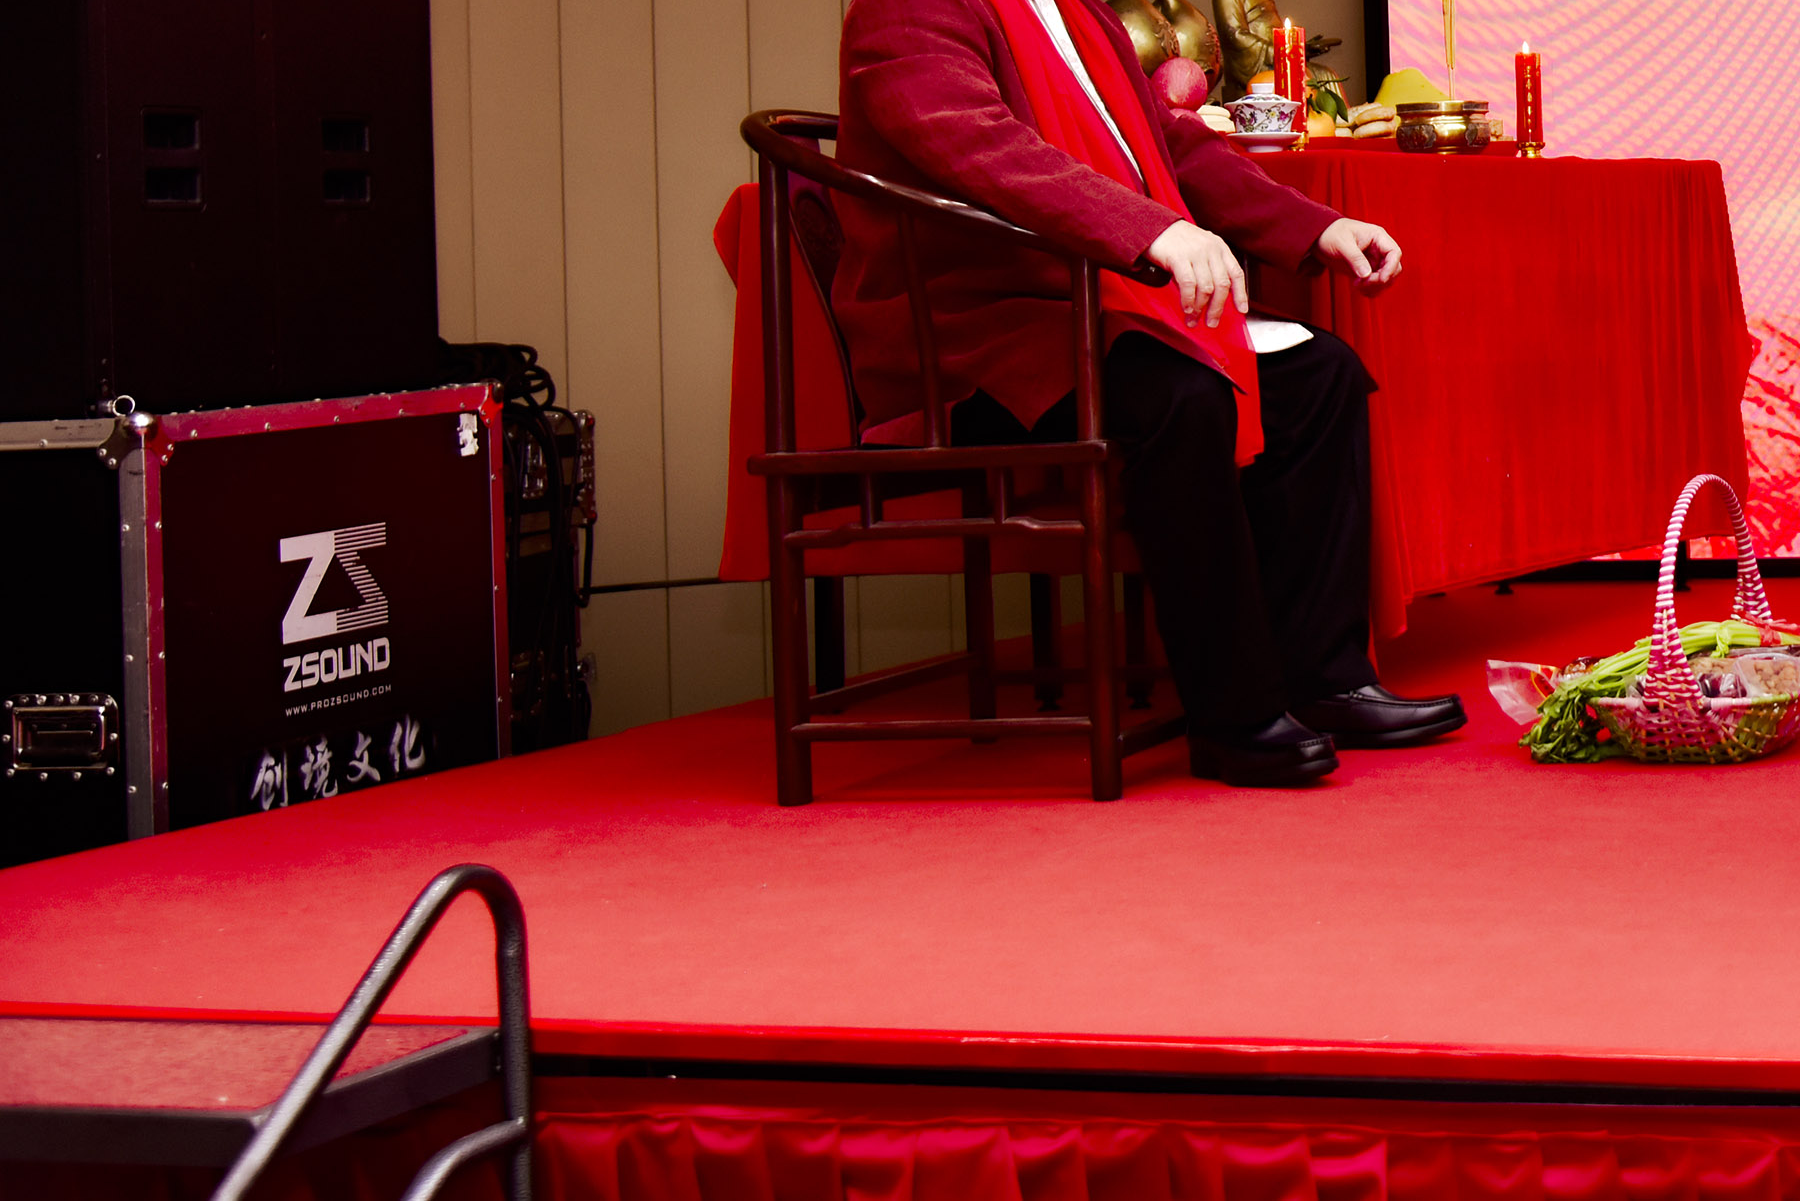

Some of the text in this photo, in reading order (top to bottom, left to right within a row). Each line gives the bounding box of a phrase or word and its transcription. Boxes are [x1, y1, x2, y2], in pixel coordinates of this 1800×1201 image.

[283, 636, 391, 693] ZSOUND
[285, 683, 393, 717] WWW.PROZSOUND.COM
[250, 714, 427, 811] 创境文化
